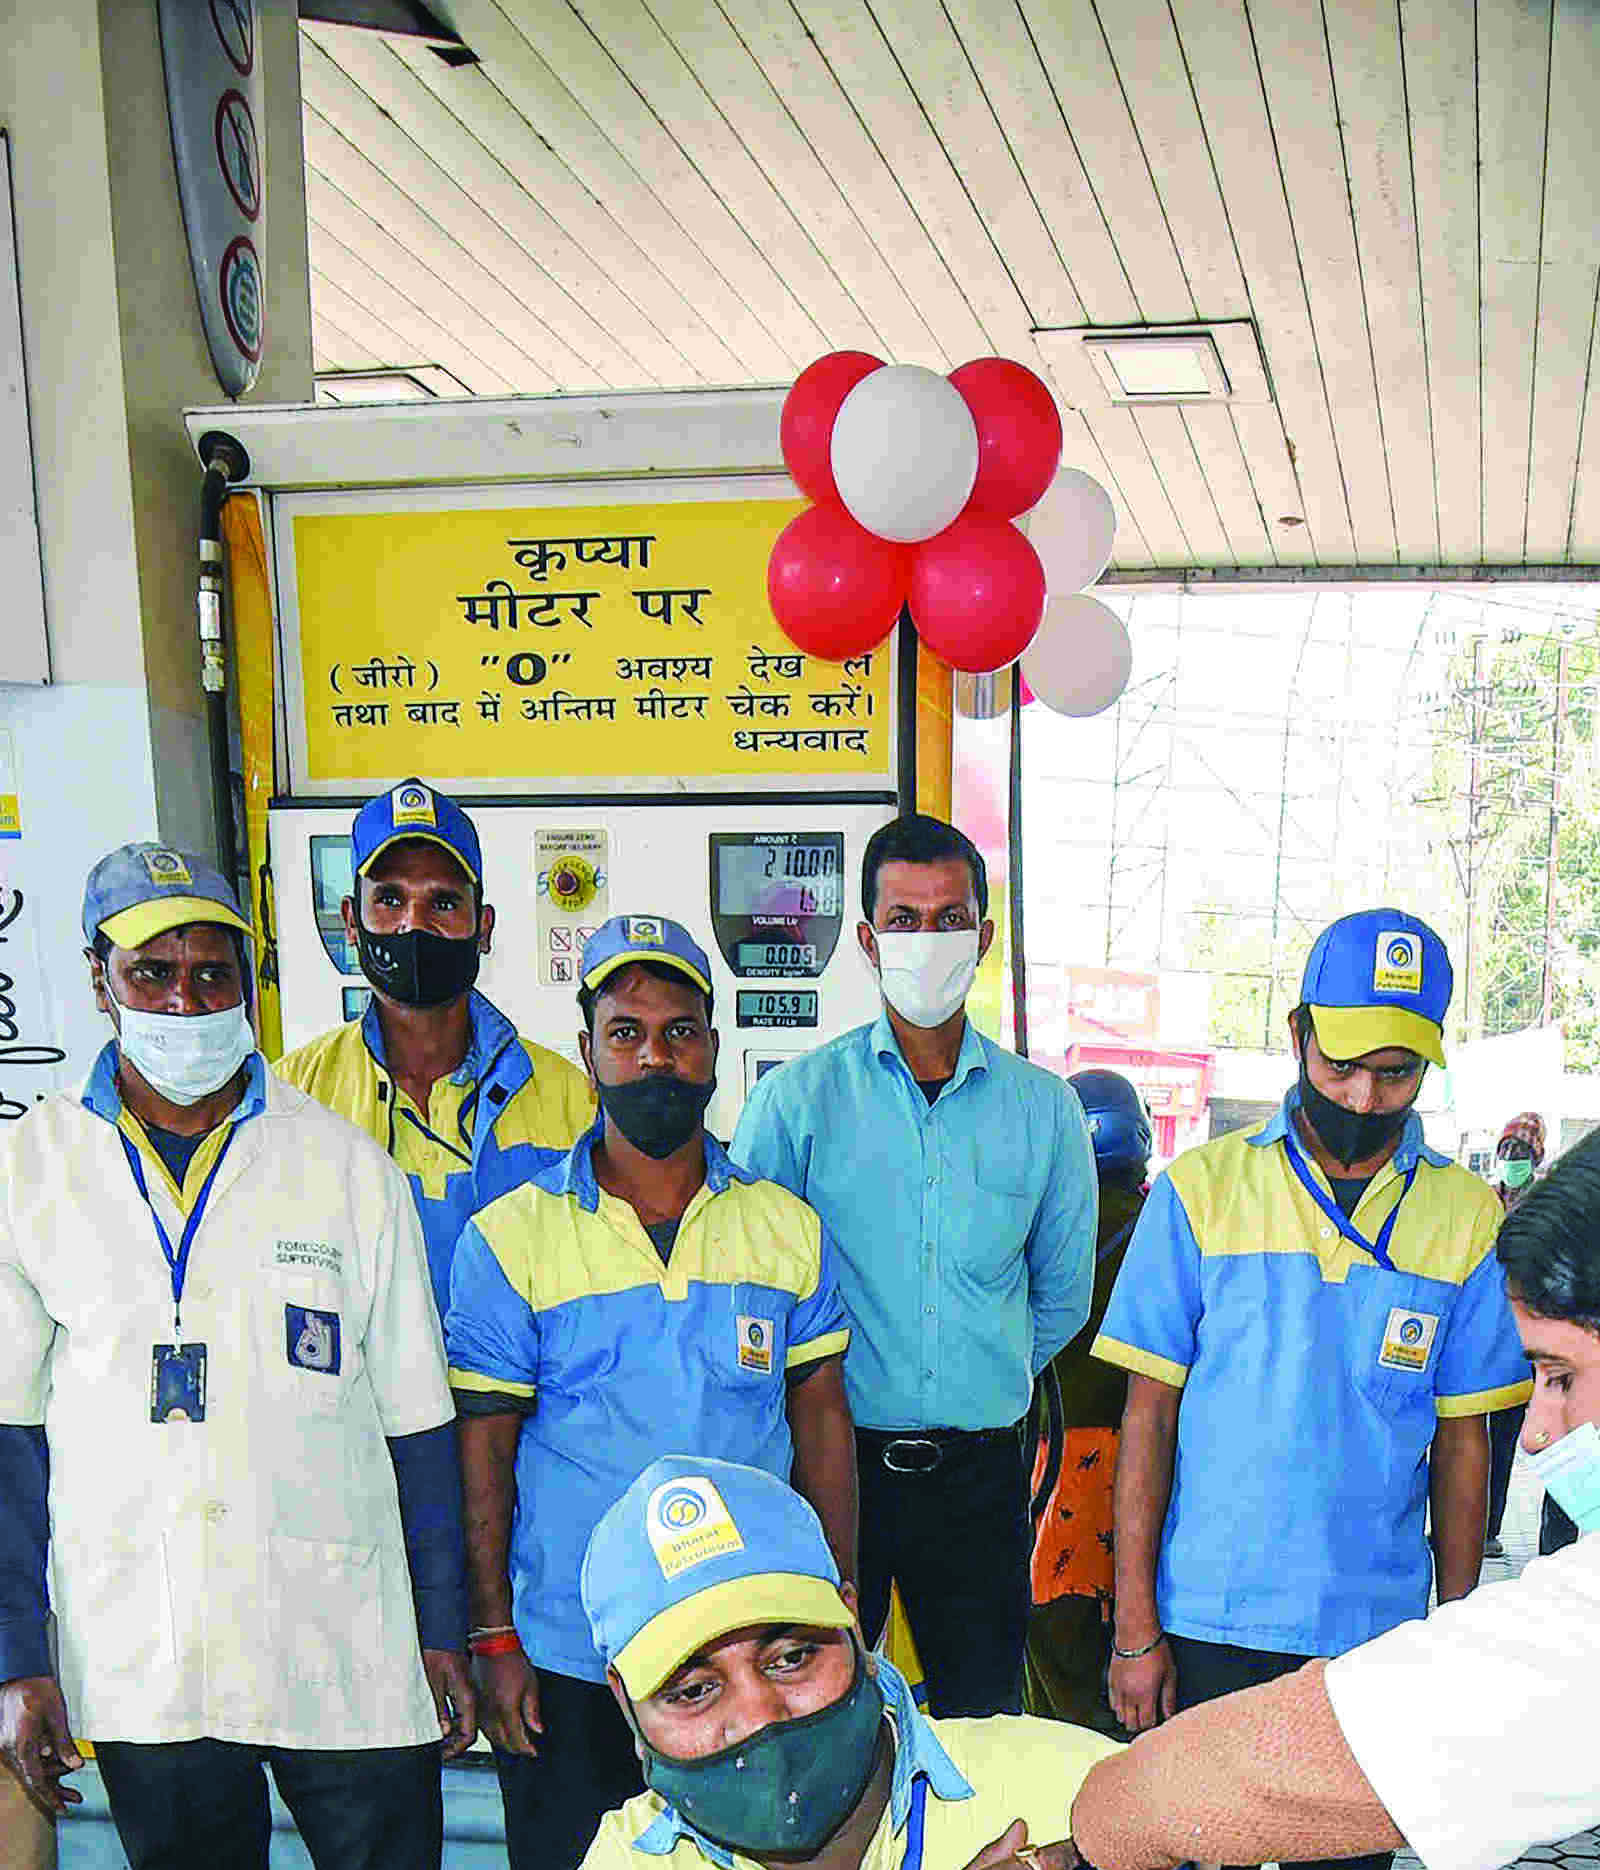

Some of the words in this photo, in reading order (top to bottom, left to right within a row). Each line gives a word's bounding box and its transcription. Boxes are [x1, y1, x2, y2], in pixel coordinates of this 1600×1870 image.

[507, 536, 656, 581] कृप्या
[456, 581, 600, 630] मीटर
[632, 589, 712, 624] पर
[616, 656, 713, 681] अवश्य
[746, 645, 805, 682] देख
[332, 703, 389, 727] तथा
[405, 702, 461, 728] बाद
[476, 691, 501, 722] में
[522, 691, 617, 721] अन्तिम
[634, 688, 709, 719] मीटर
[726, 685, 791, 718] चेक
[734, 729, 869, 755] धन्यवाद
